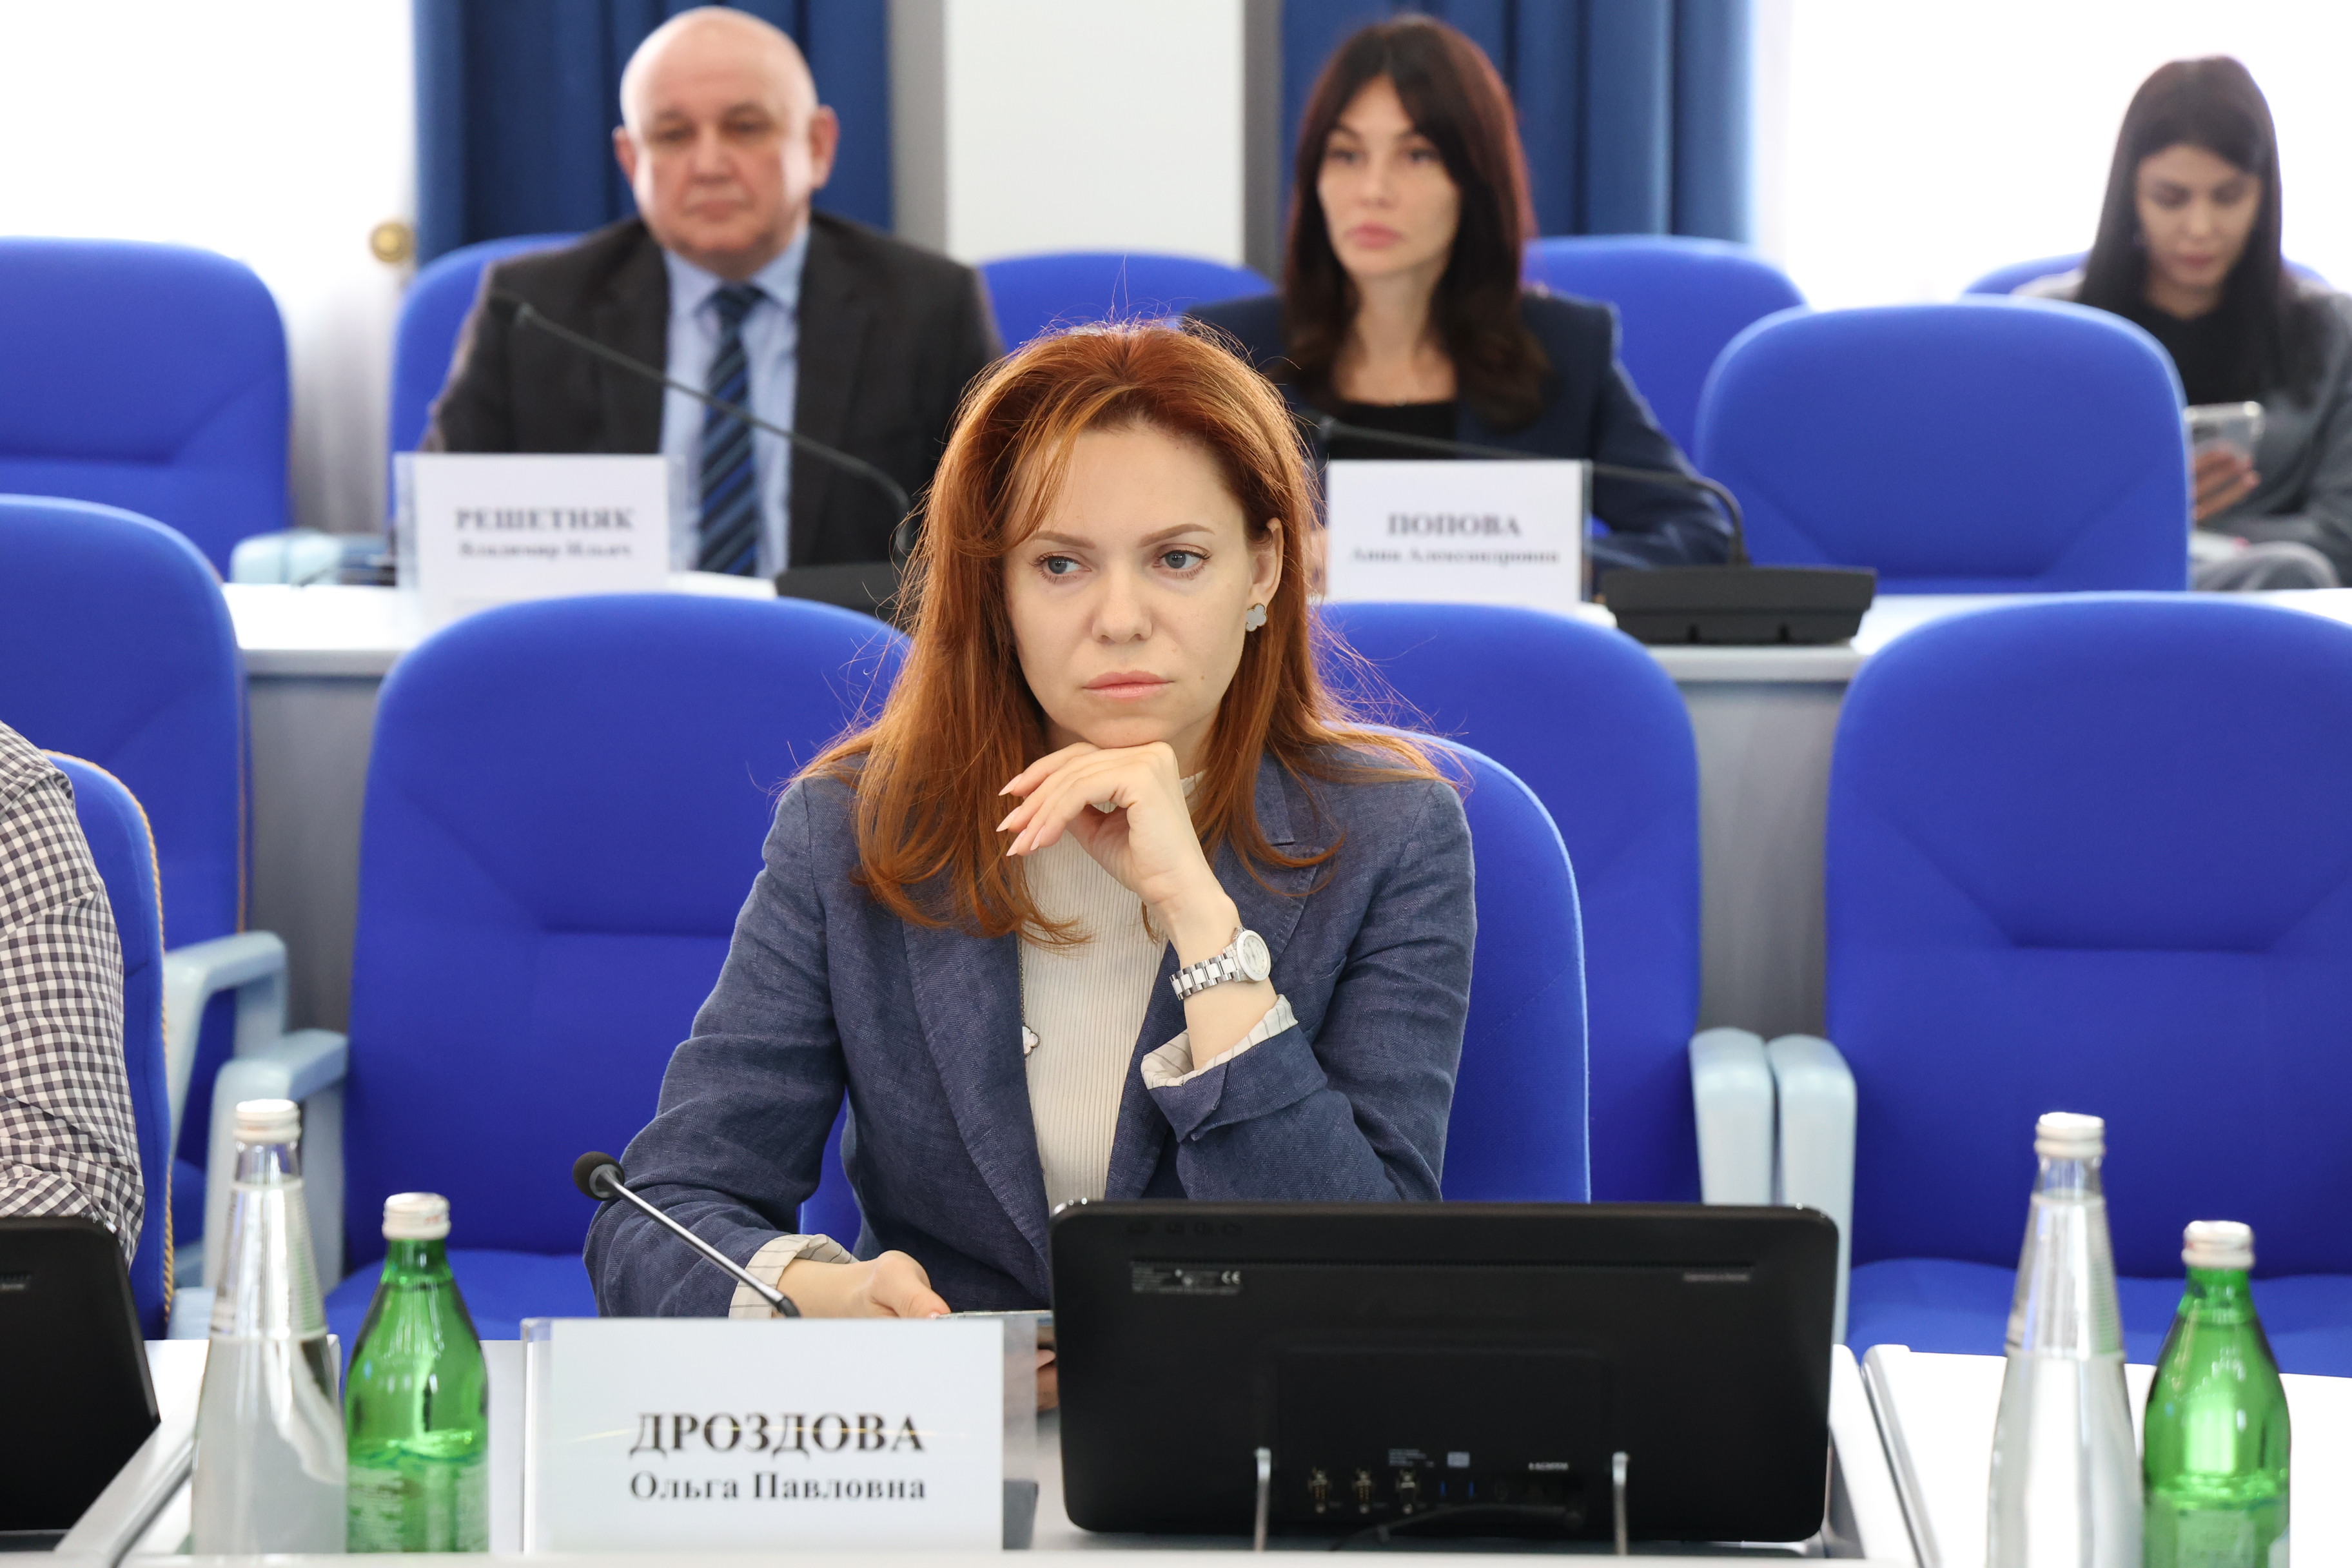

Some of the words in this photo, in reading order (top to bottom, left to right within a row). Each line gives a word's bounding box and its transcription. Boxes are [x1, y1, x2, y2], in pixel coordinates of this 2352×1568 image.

[455, 507, 634, 531] РЕШЕТНЯК
[1387, 511, 1521, 536] ПОПОВА
[459, 540, 560, 562] Владимир
[1409, 547, 1560, 567] Александровна
[628, 1412, 926, 1459] ДРОЗДОВА
[630, 1471, 739, 1500] Ольга
[752, 1472, 927, 1500] Павловна
